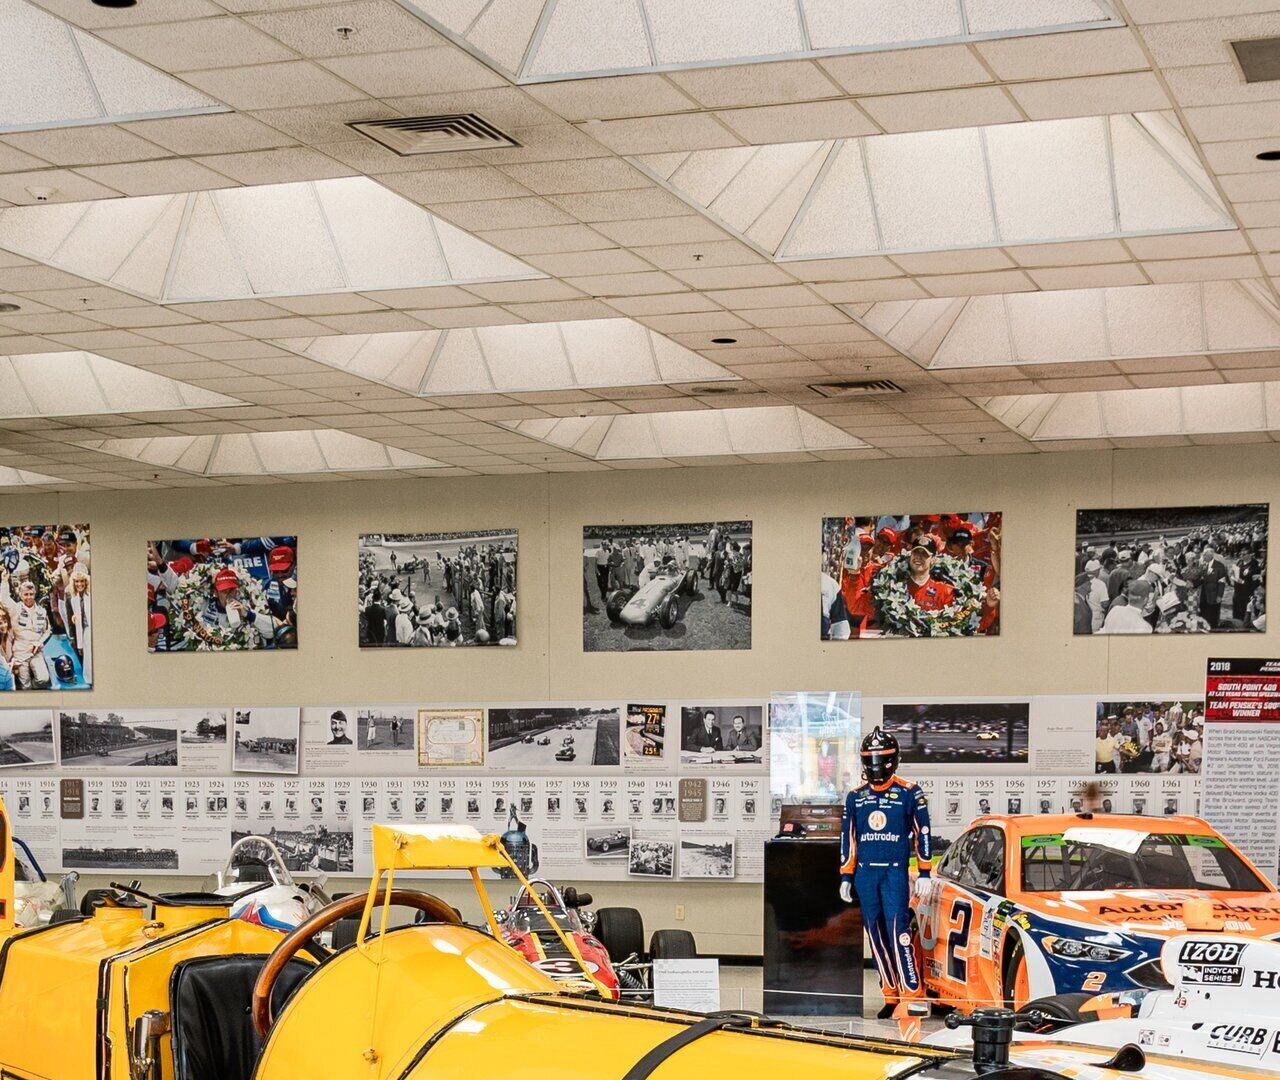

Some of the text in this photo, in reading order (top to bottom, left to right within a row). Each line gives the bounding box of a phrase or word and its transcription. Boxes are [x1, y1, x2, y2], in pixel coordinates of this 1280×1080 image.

[1210, 662, 1231, 671] 2018
[946, 897, 973, 985] 2
[1181, 943, 1238, 962] IZOD
[1204, 966, 1238, 975] INDYCAR
[1204, 974, 1233, 982] SERIES
[1080, 971, 1107, 992] 2
[1210, 1024, 1268, 1047] CURB
